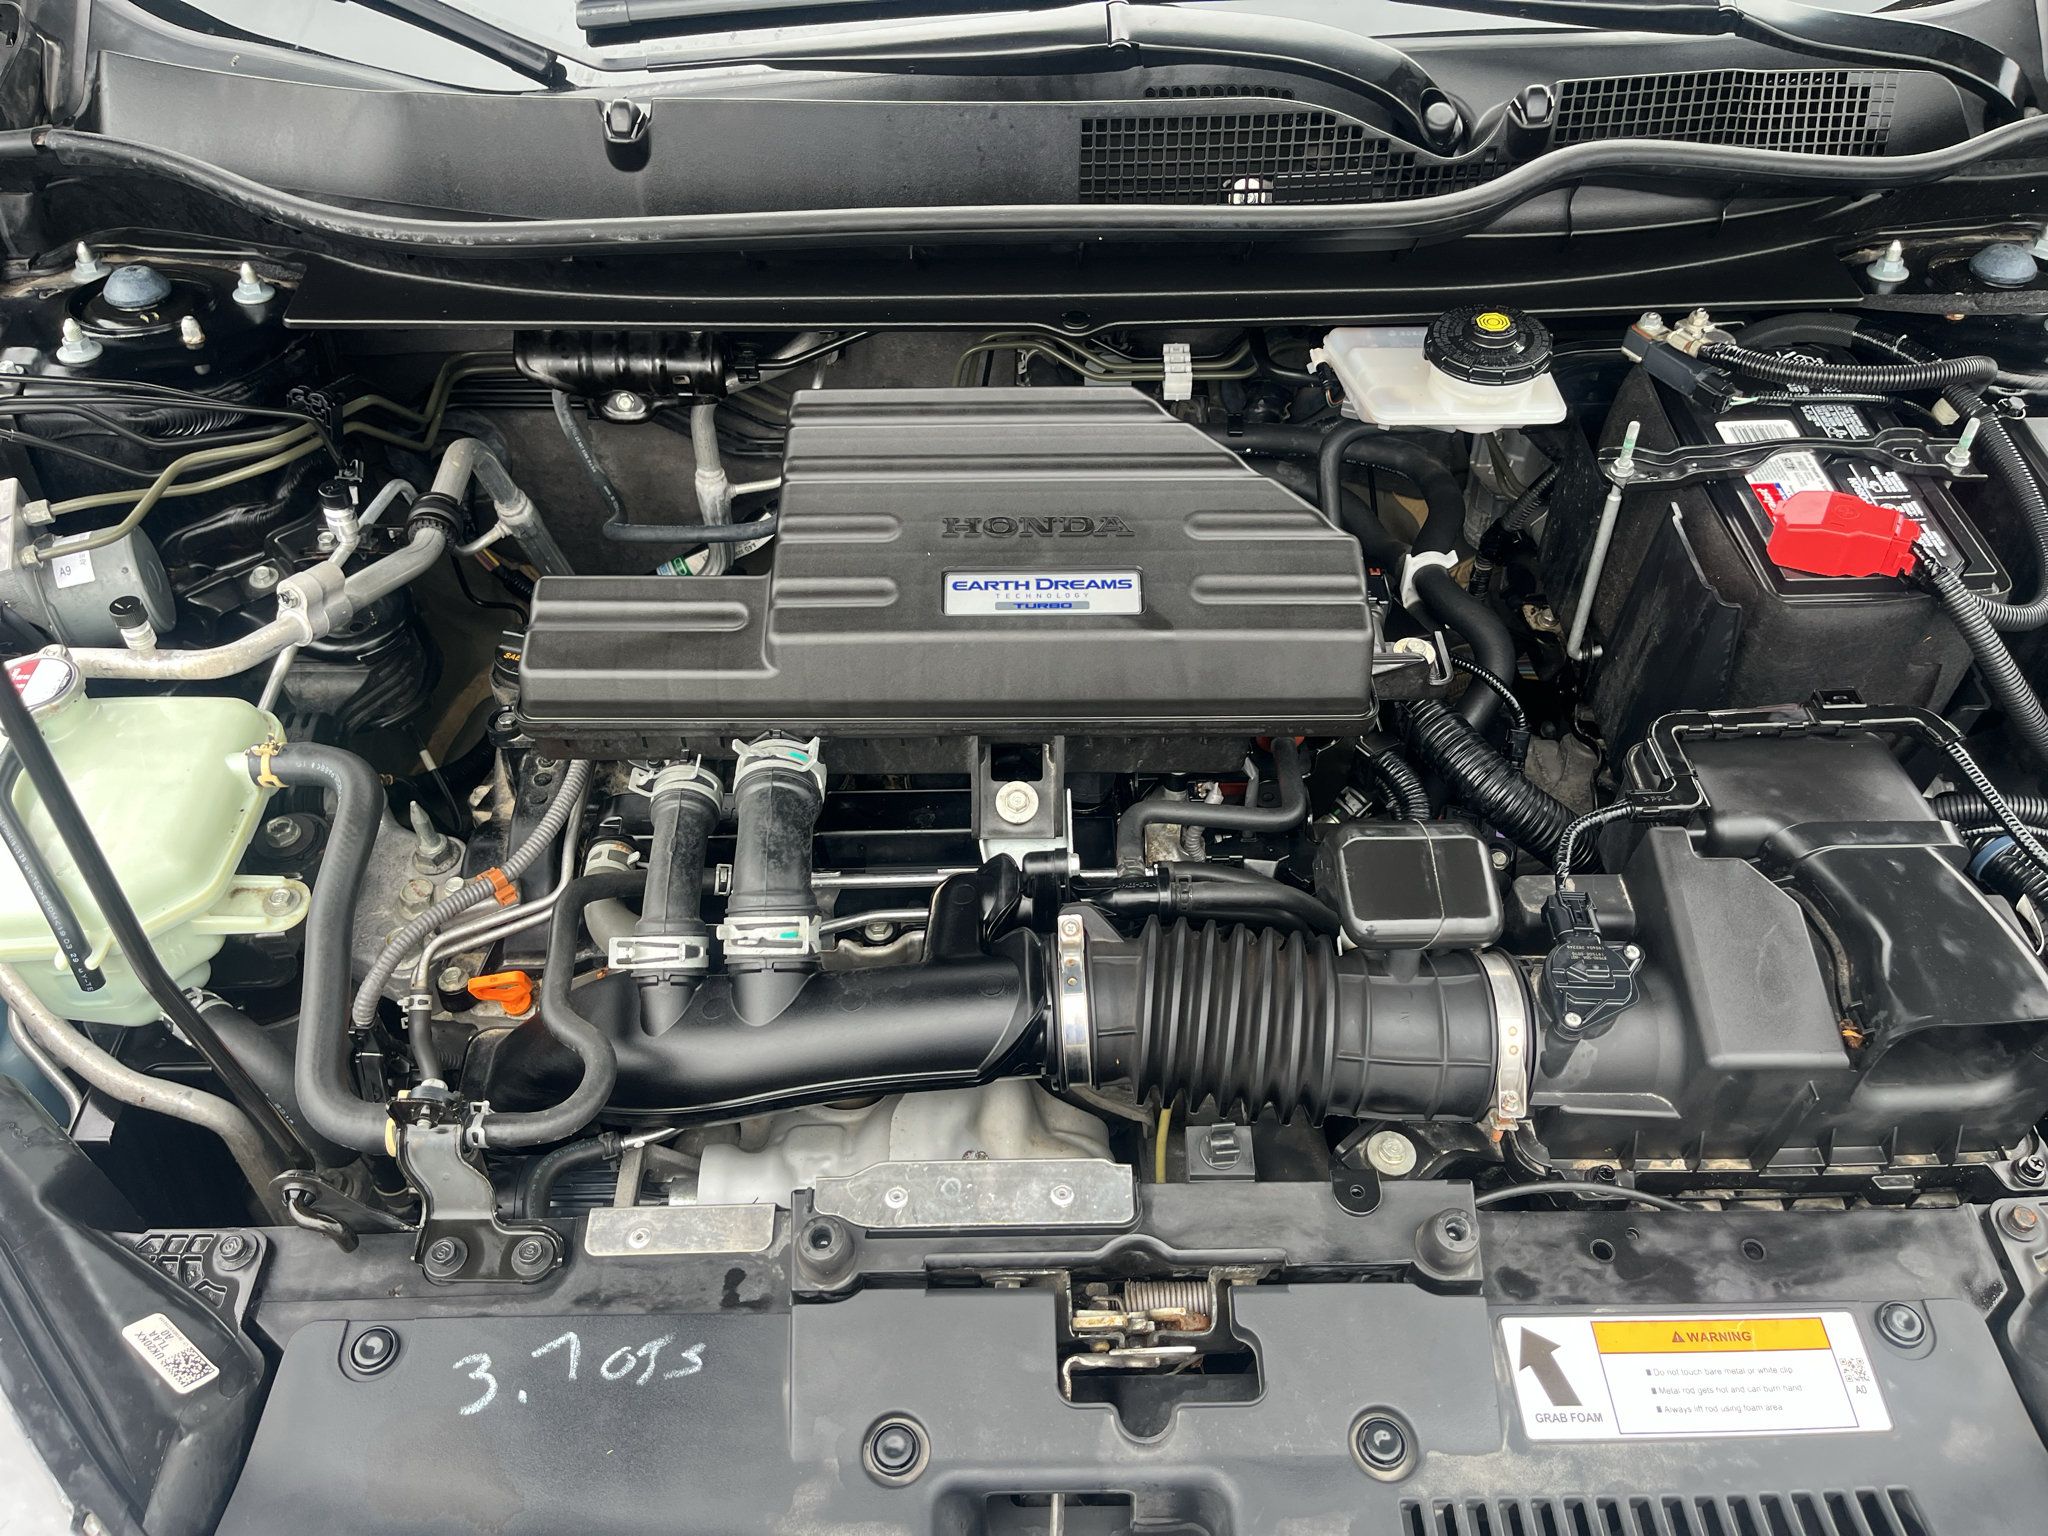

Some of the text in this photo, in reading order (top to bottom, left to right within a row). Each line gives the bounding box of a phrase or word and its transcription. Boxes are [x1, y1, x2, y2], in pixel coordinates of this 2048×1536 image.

[942, 516, 1135, 538] HONDA
[60, 565, 71, 576] A9
[952, 578, 1132, 591] EARTH DREAMS
[1687, 1331, 1752, 1343] WARNING
[1654, 1368, 1665, 1376] Do
[1667, 1368, 1679, 1376] not
[1780, 1367, 1793, 1375] clip
[1658, 1387, 1680, 1395] Metal
[1698, 1387, 1714, 1396] gets
[1665, 1406, 1692, 1414] Always
[1721, 1405, 1742, 1413] using
[1535, 1411, 1604, 1424] GRAB FOAM
